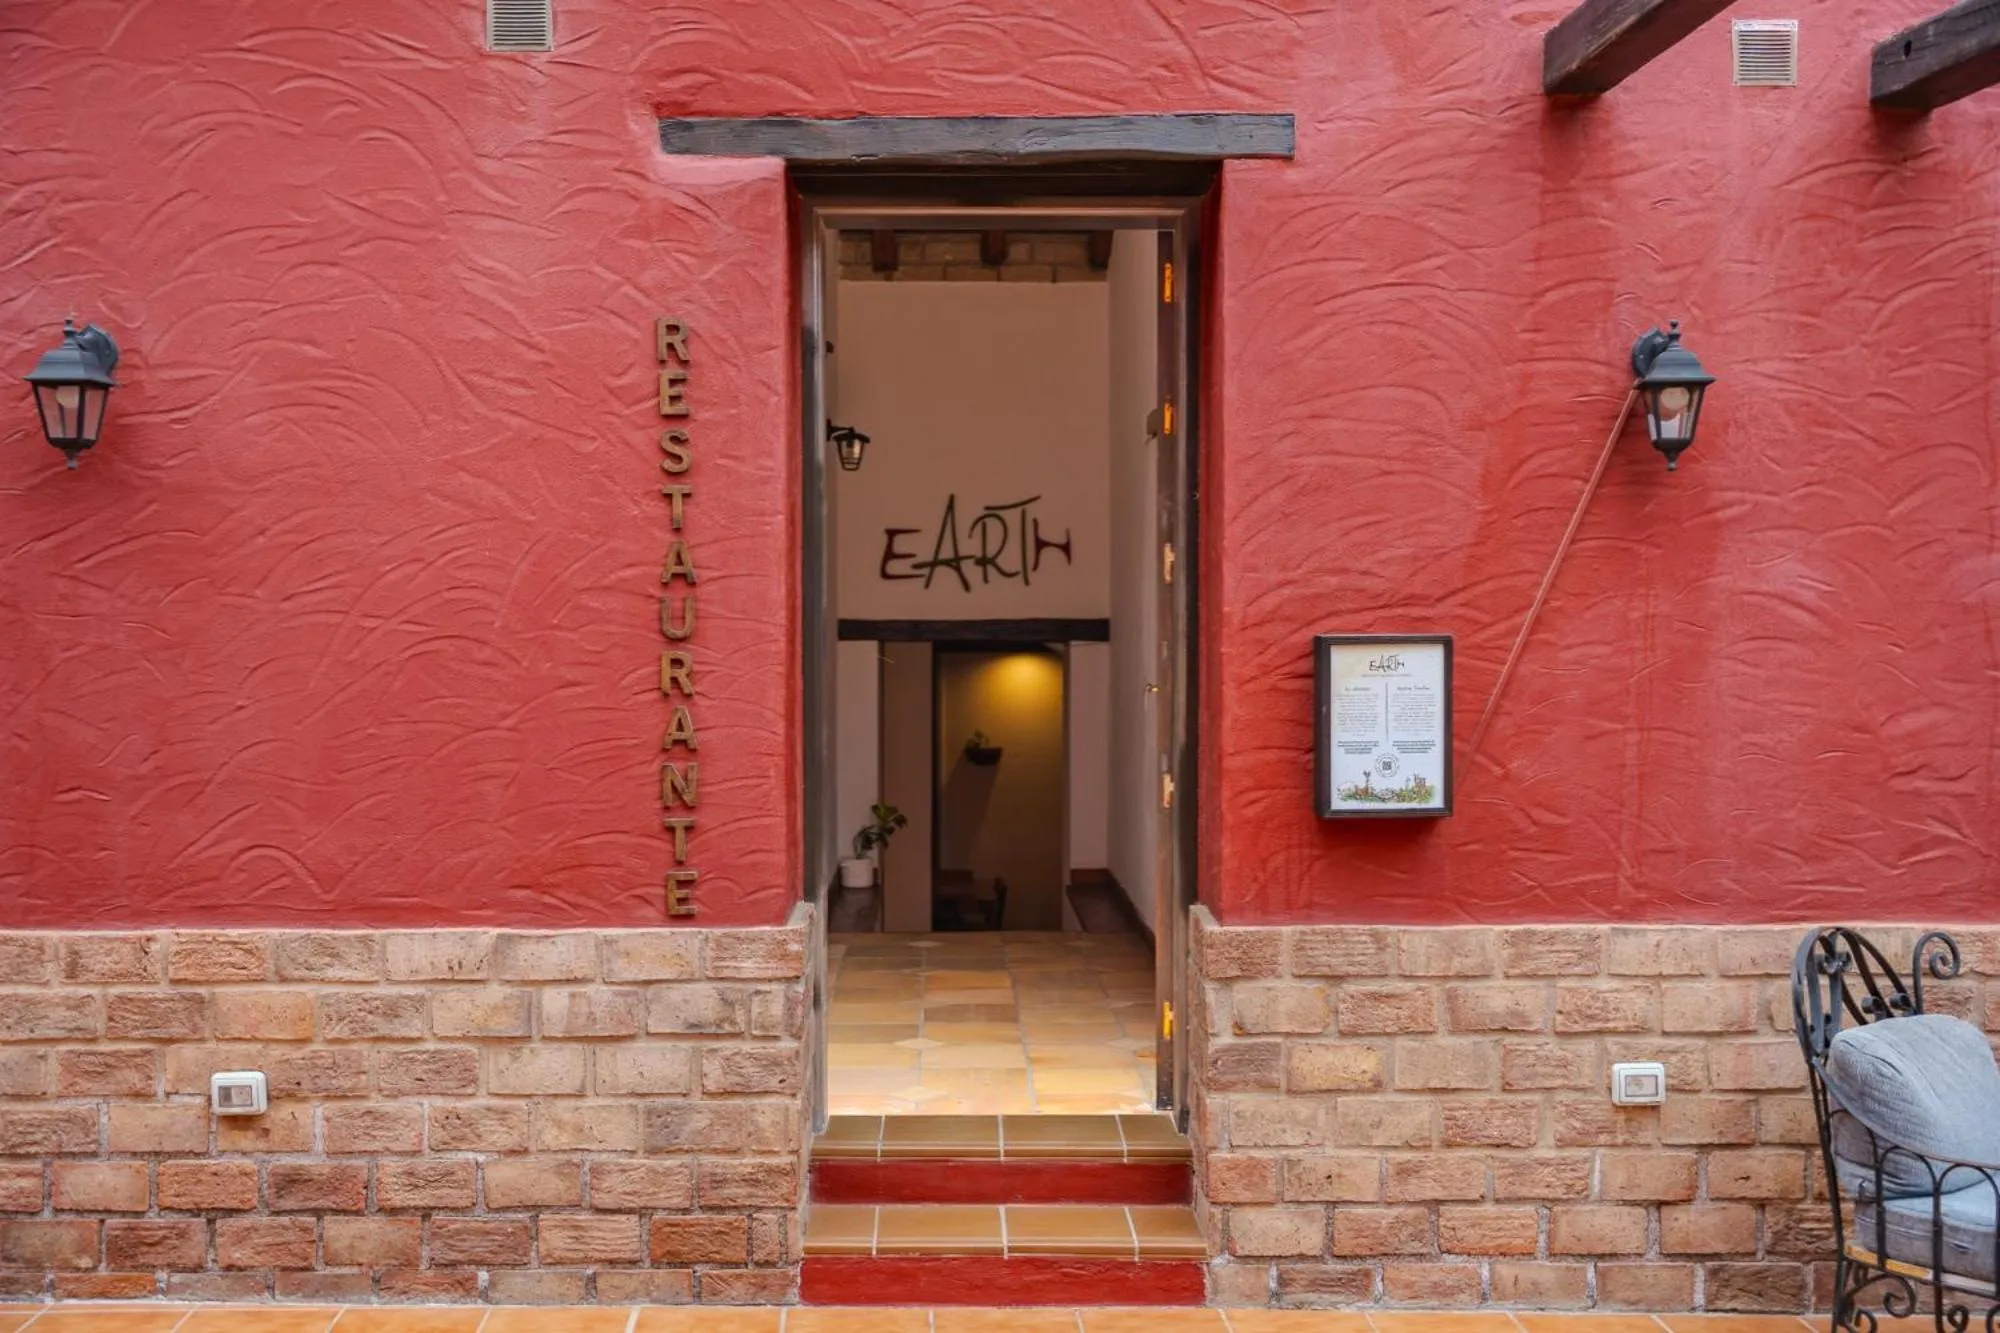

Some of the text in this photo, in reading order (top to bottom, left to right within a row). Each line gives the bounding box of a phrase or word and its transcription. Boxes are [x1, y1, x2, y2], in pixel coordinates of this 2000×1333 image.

[880, 494, 1072, 592] EARTH
[655, 317, 697, 917] RESTAURANTE
[1369, 654, 1405, 672] EARTH
